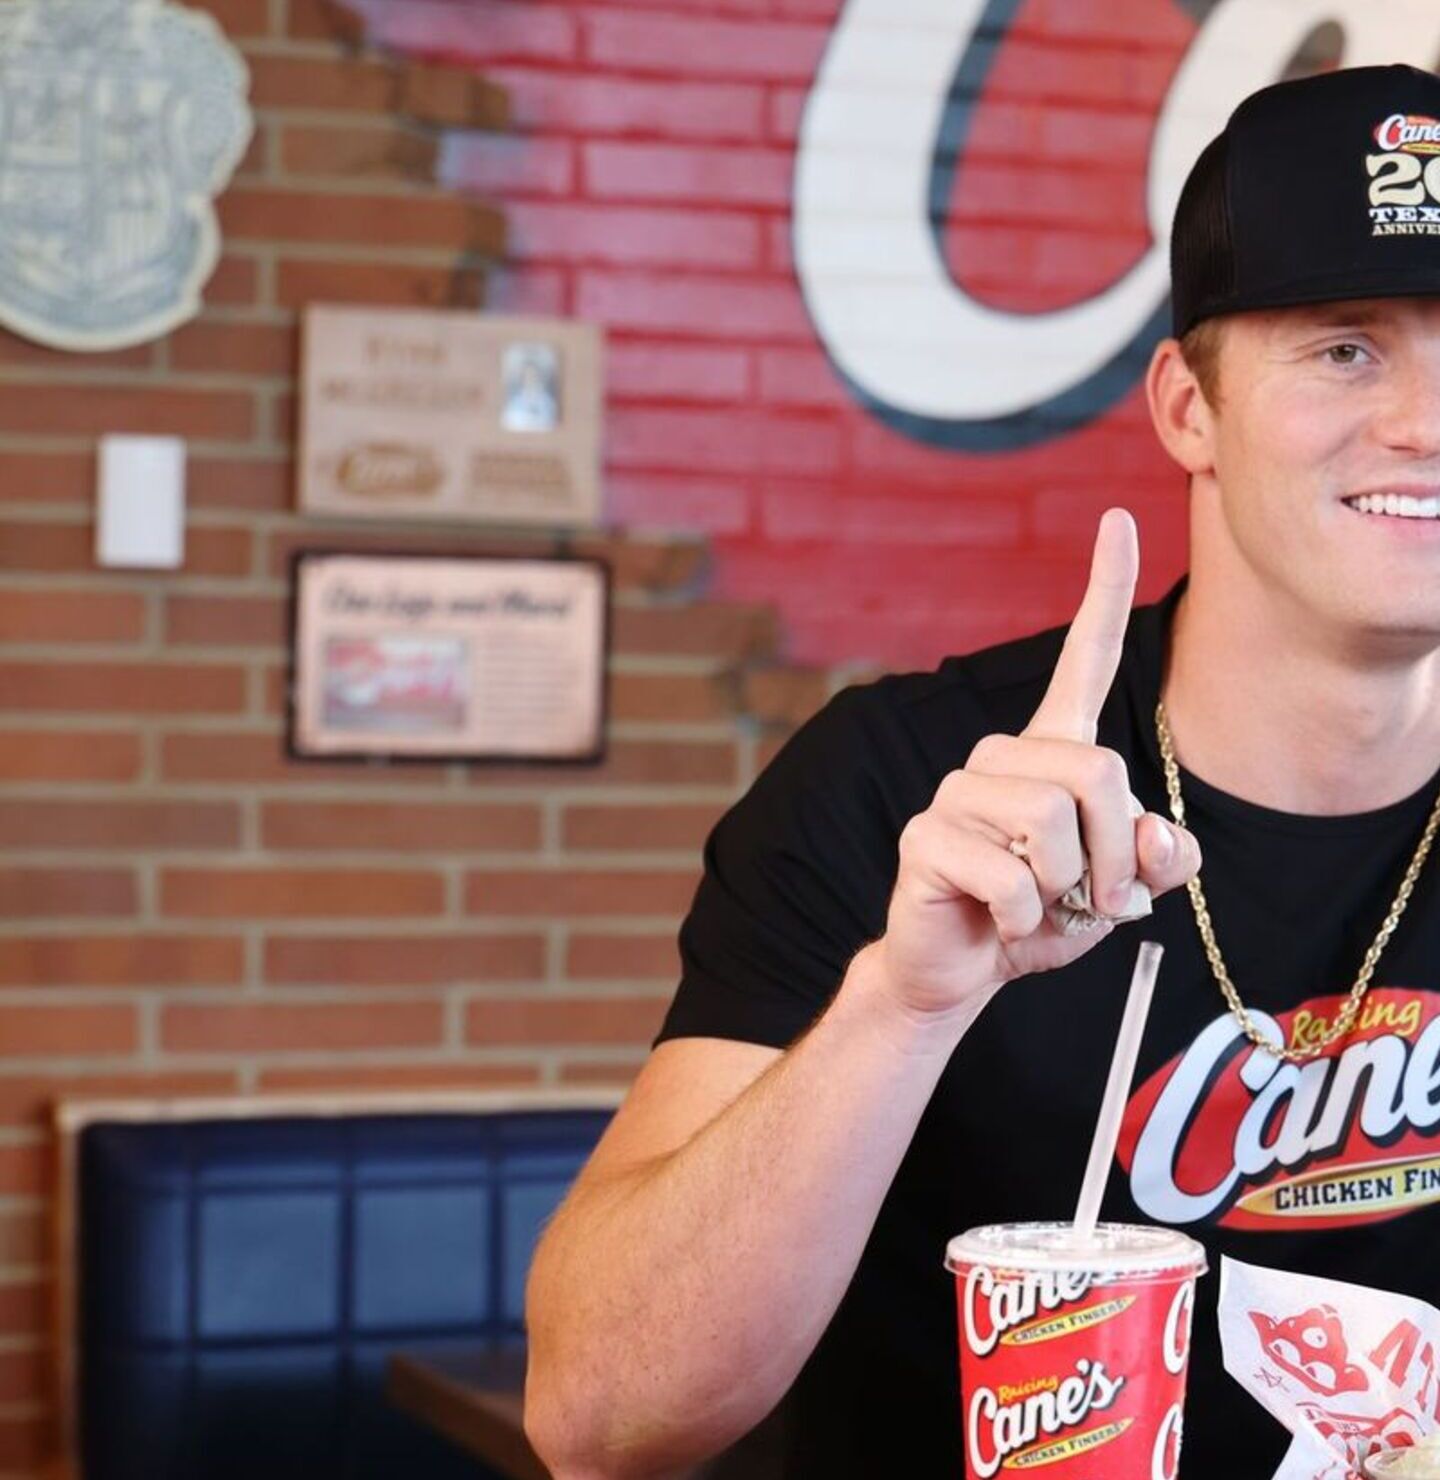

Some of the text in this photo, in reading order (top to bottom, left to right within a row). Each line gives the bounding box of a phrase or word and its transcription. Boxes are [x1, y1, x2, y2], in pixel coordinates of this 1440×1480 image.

[1290, 996, 1421, 1050] Raing
[1275, 1175, 1393, 1210] CHICKEN
[967, 1358, 1125, 1479] Cane's
